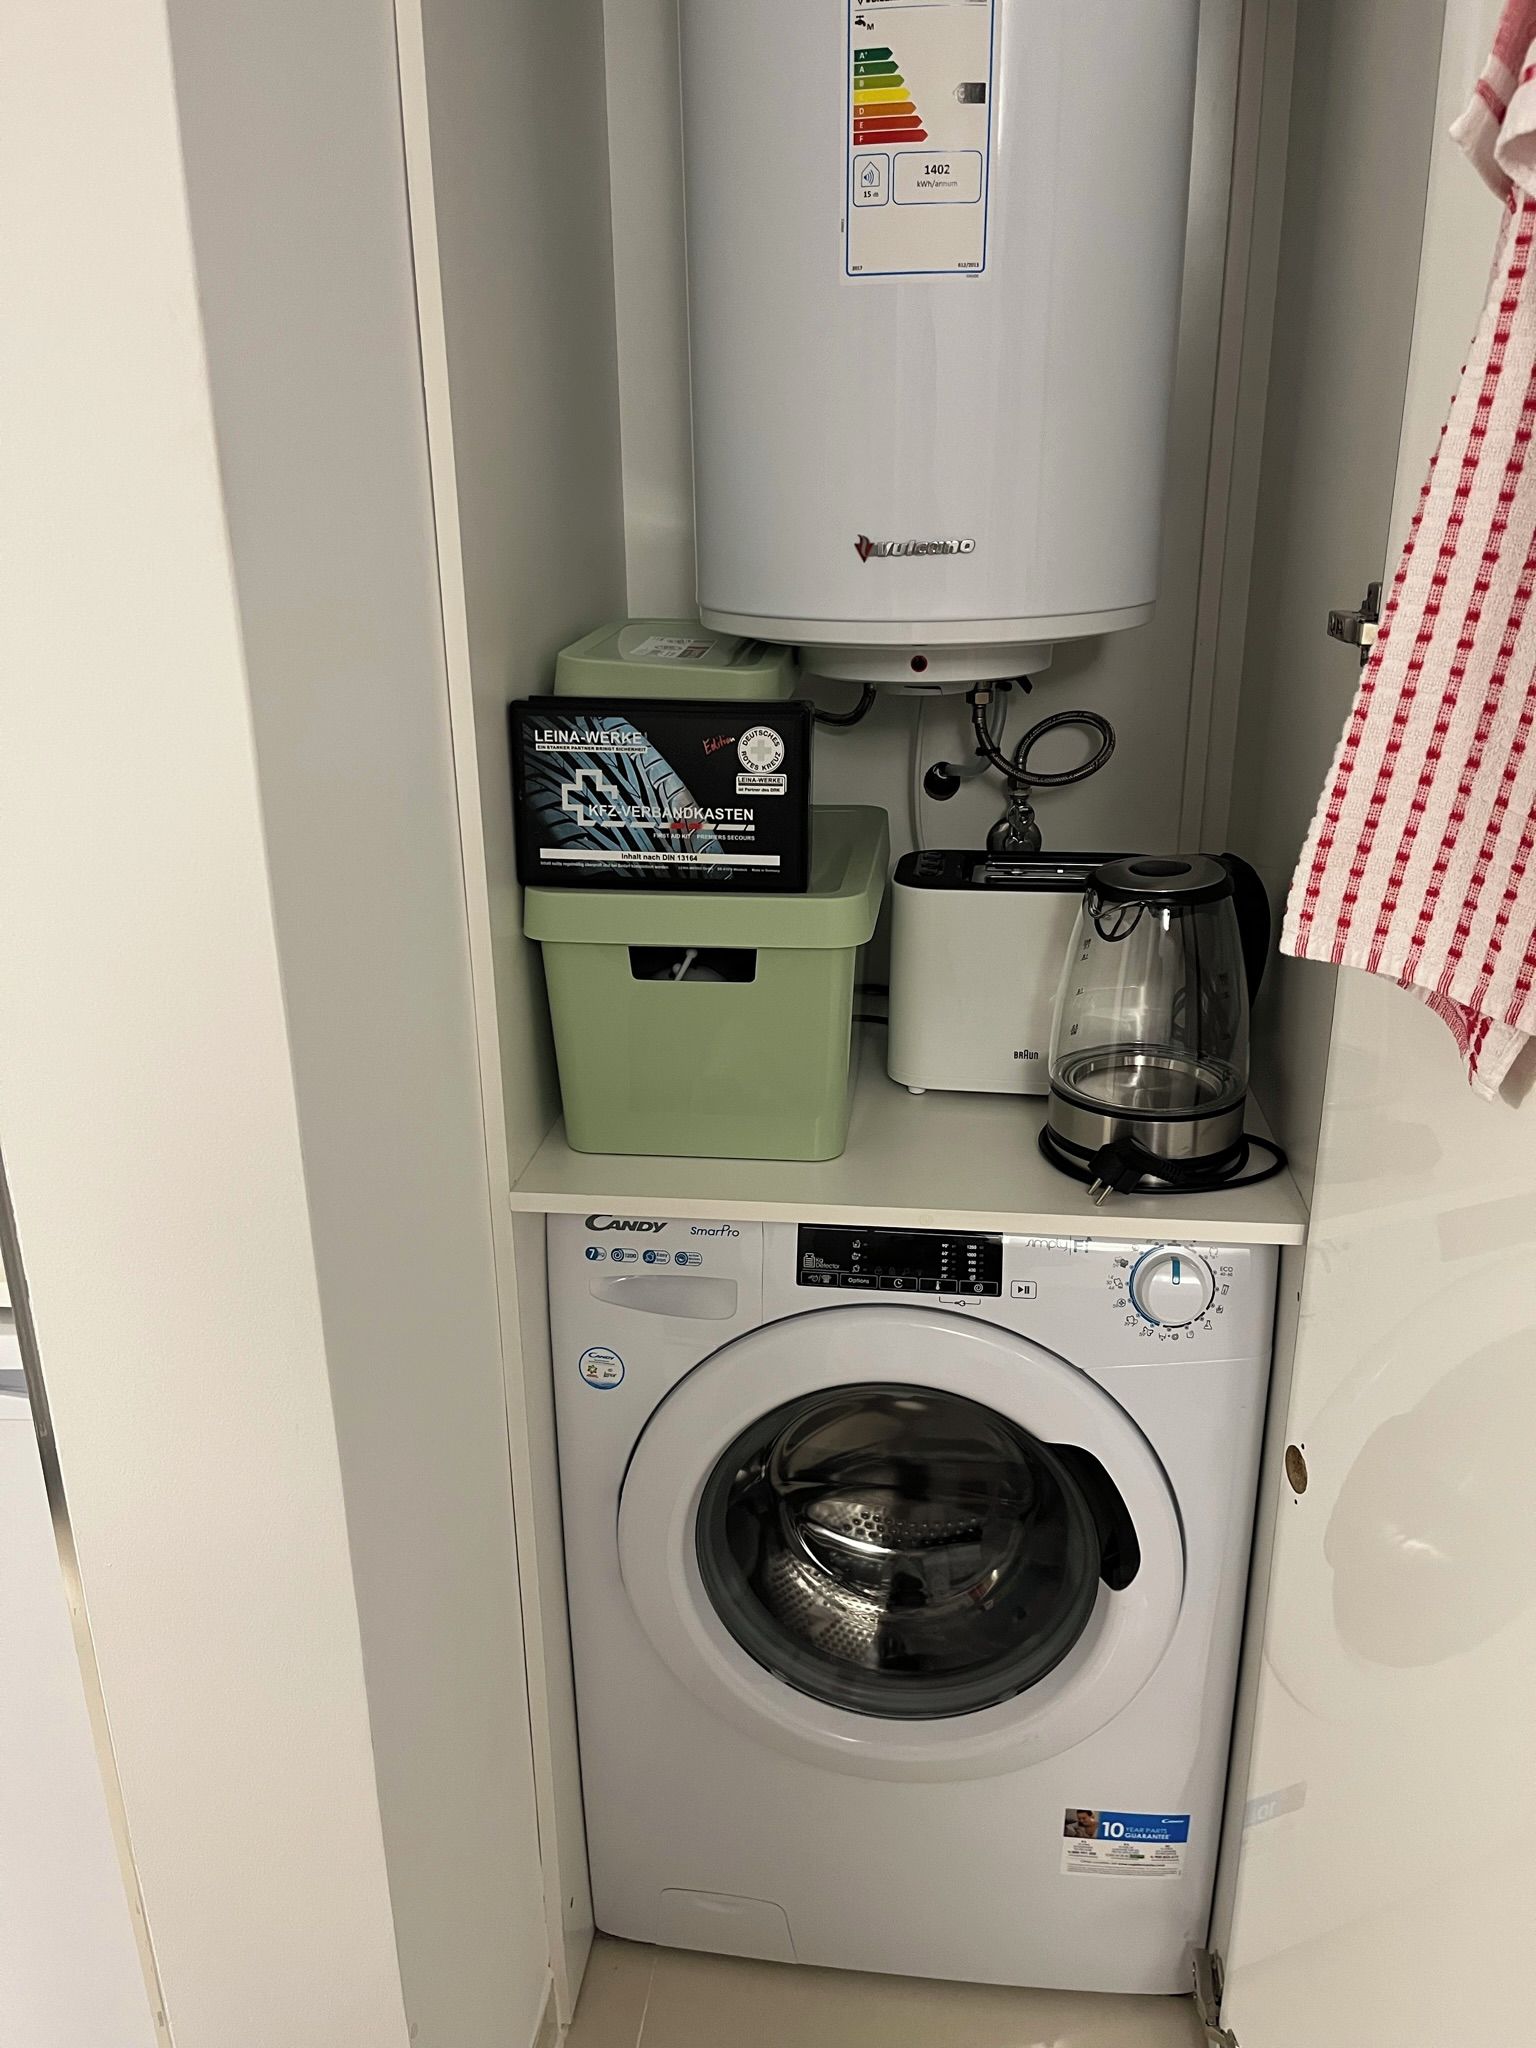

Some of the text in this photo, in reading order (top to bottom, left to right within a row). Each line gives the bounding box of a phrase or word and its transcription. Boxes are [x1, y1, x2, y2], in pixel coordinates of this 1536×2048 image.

[866, 23, 875, 31] M
[859, 107, 865, 115] D
[859, 121, 864, 129] E
[859, 135, 864, 143] F
[924, 164, 951, 175] 1402
[916, 179, 958, 188] kWh/annum
[534, 729, 642, 745] LEINA-WERKE
[742, 729, 780, 747] DEUTSCHES
[741, 750, 781, 771] ROTES KREUZ
[588, 804, 755, 821] KFZ-VERBANDKASTEN
[585, 1214, 668, 1233] CANDY
[588, 1248, 596, 1259] 7
[848, 1277, 870, 1285] Options
[1102, 1821, 1125, 1838] 10
[1145, 1827, 1168, 1835] PARTS
